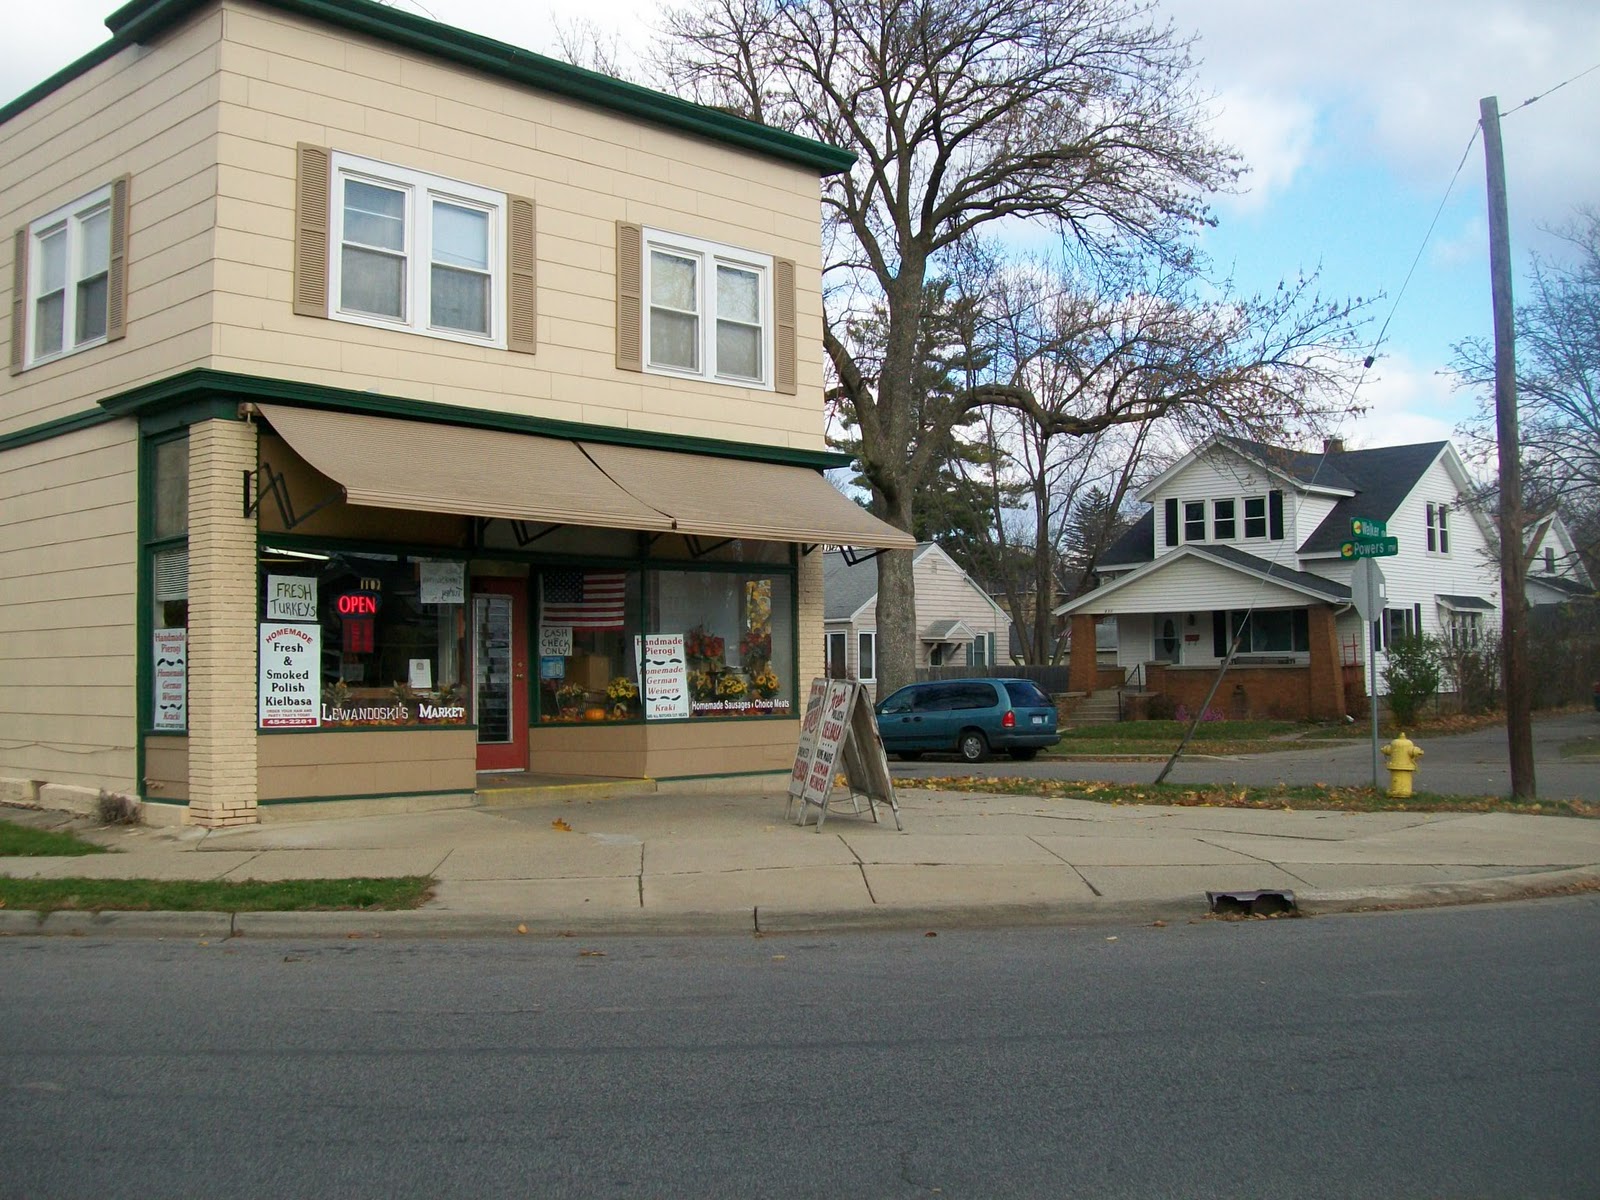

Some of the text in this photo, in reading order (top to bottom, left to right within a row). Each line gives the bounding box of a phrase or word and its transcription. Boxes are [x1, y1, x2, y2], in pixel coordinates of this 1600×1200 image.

[1354, 541, 1384, 555] Powers
[276, 582, 313, 602] FRESH
[269, 598, 316, 617] TURKEYS
[338, 595, 376, 614] OPEN
[265, 627, 314, 645] HOMEMADE
[544, 629, 568, 639] CASH
[273, 642, 304, 653] Fresh
[541, 638, 570, 649] CHECK
[645, 646, 676, 656] Pierogi
[283, 656, 293, 667] &
[266, 669, 309, 680] Smoked
[639, 665, 684, 676] omemade
[646, 676, 678, 685] German
[271, 682, 305, 693] Polish
[648, 687, 680, 695] Weiners
[265, 696, 313, 706] Kielbasa
[691, 698, 790, 712] Homemade Sausages Choice Meats
[321, 702, 465, 721] LEWANDOSKI'S MARKET
[655, 704, 676, 713] Kraki
